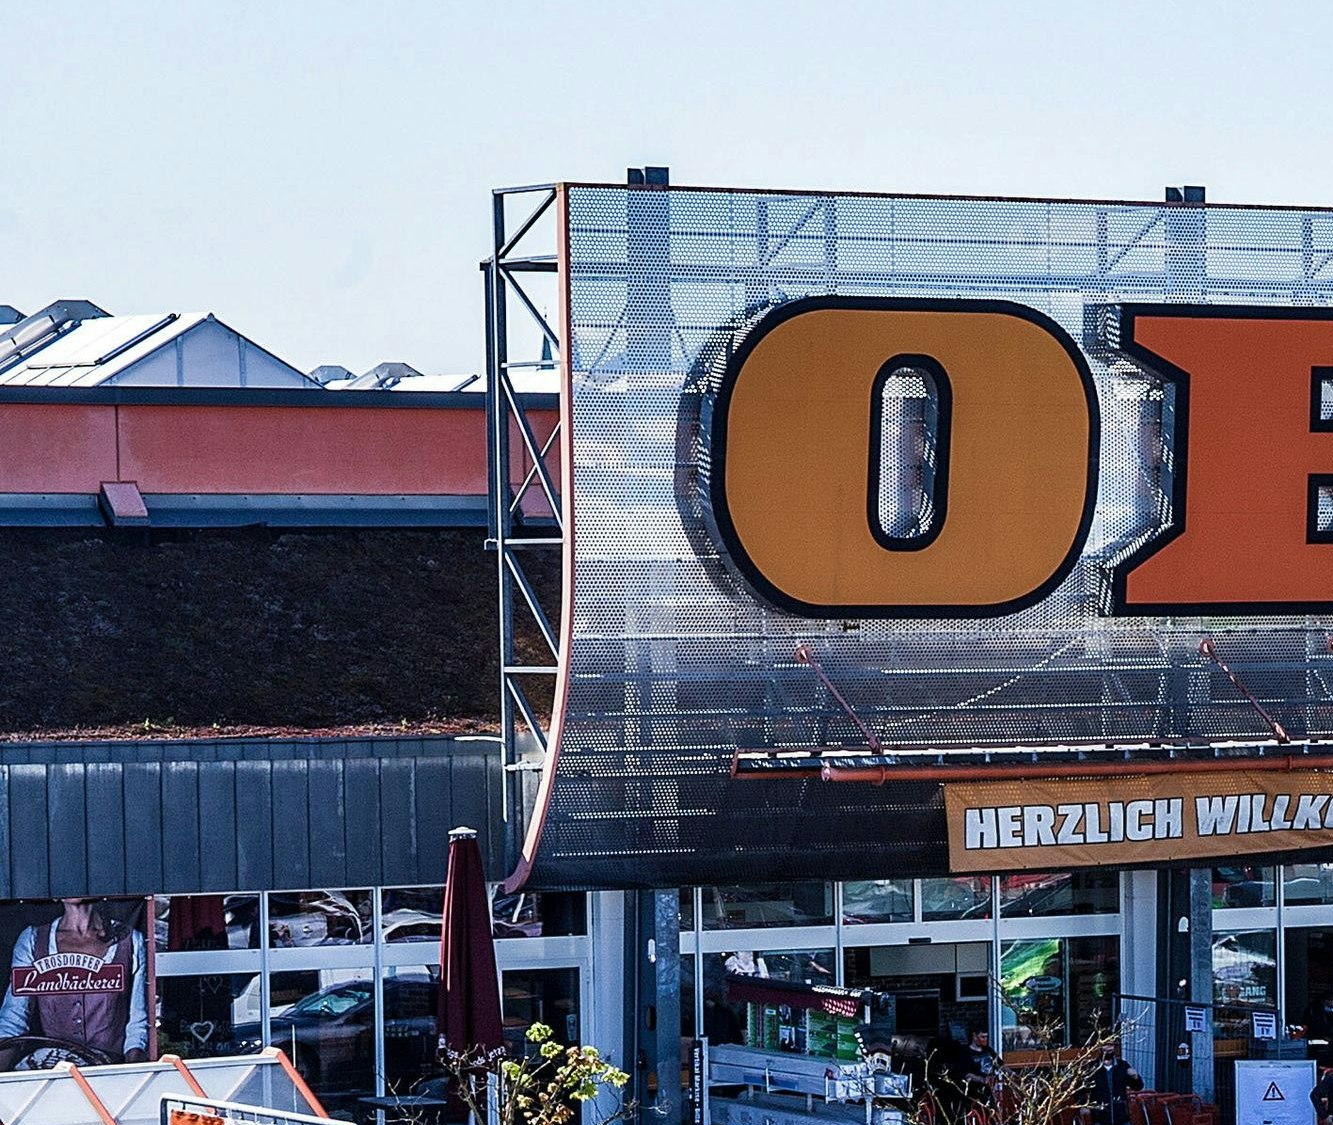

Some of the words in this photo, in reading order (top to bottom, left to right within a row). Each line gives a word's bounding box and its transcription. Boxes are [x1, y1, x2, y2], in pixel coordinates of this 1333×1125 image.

[965, 797, 1184, 850] HERZLICH
[37, 954, 101, 973] TROSDORFER
[16, 970, 122, 992] Landbäckerei
